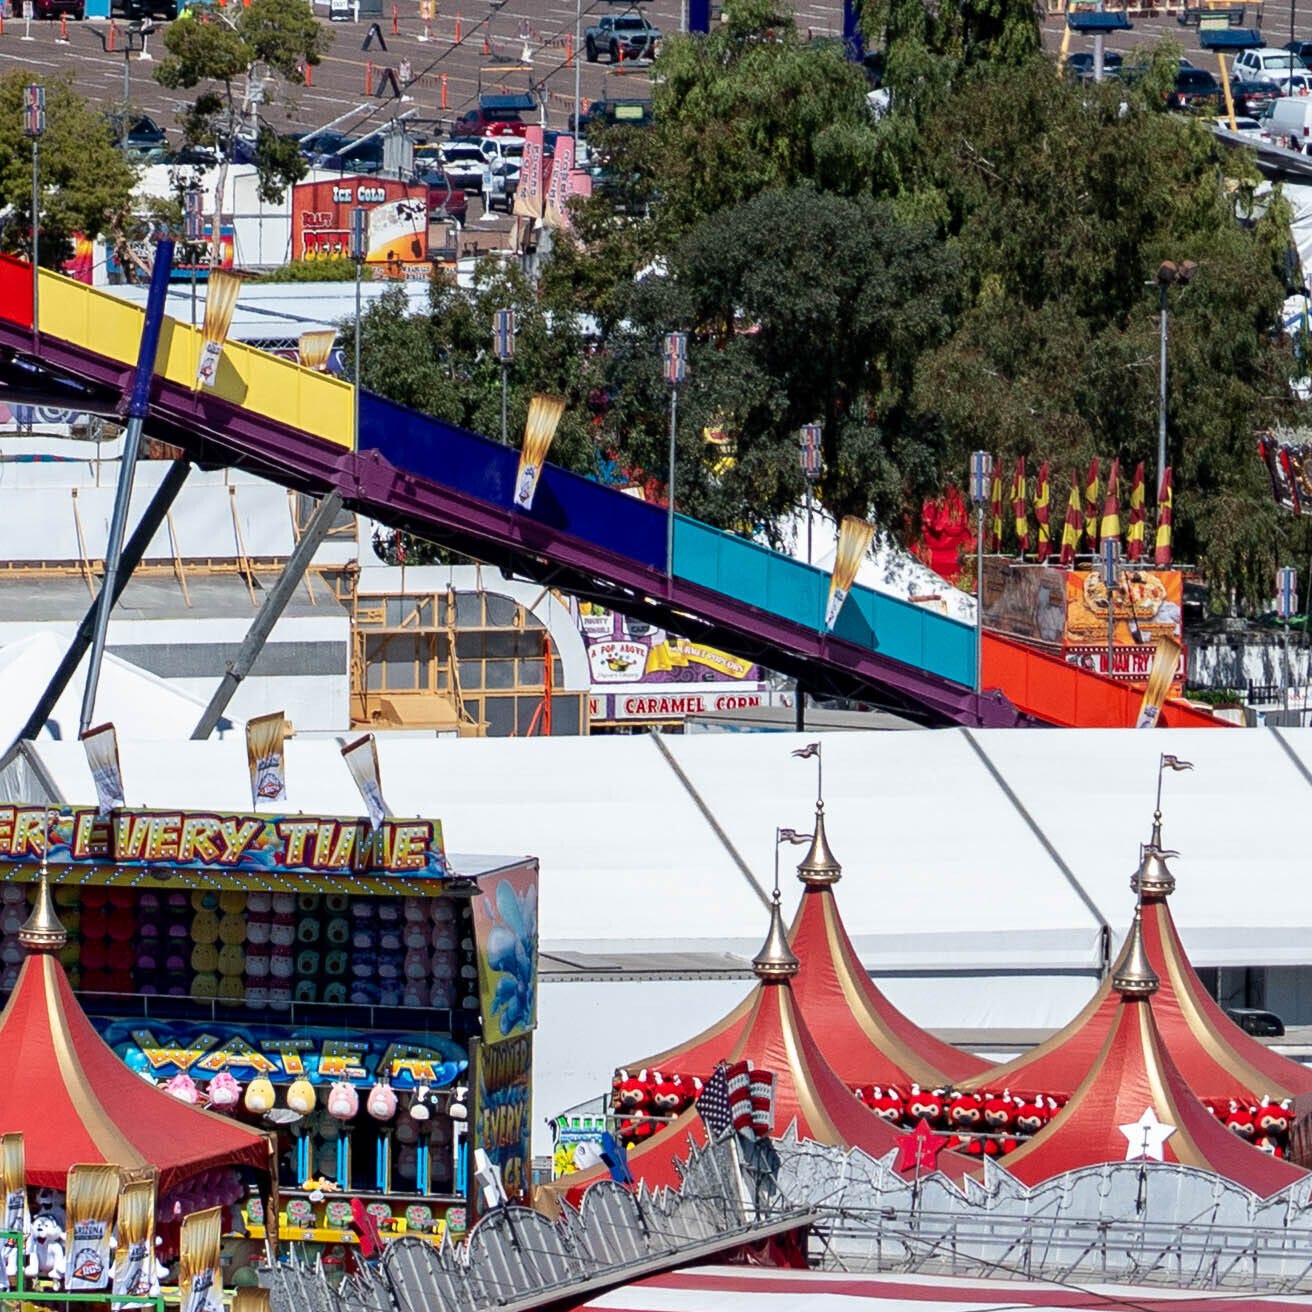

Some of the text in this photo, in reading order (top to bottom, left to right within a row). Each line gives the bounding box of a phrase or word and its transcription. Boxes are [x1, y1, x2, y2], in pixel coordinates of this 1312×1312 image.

[333, 187, 385, 203] ICE COLD
[601, 644, 616, 653] POP
[620, 644, 645, 657] ABOVE
[1133, 654, 1149, 672] FRY
[625, 695, 760, 715] CARAMEL CORN
[74, 812, 257, 866] EVERY
[279, 819, 430, 871] TIME
[130, 1028, 445, 1081] WATER
[483, 1102, 524, 1150] EVERY
